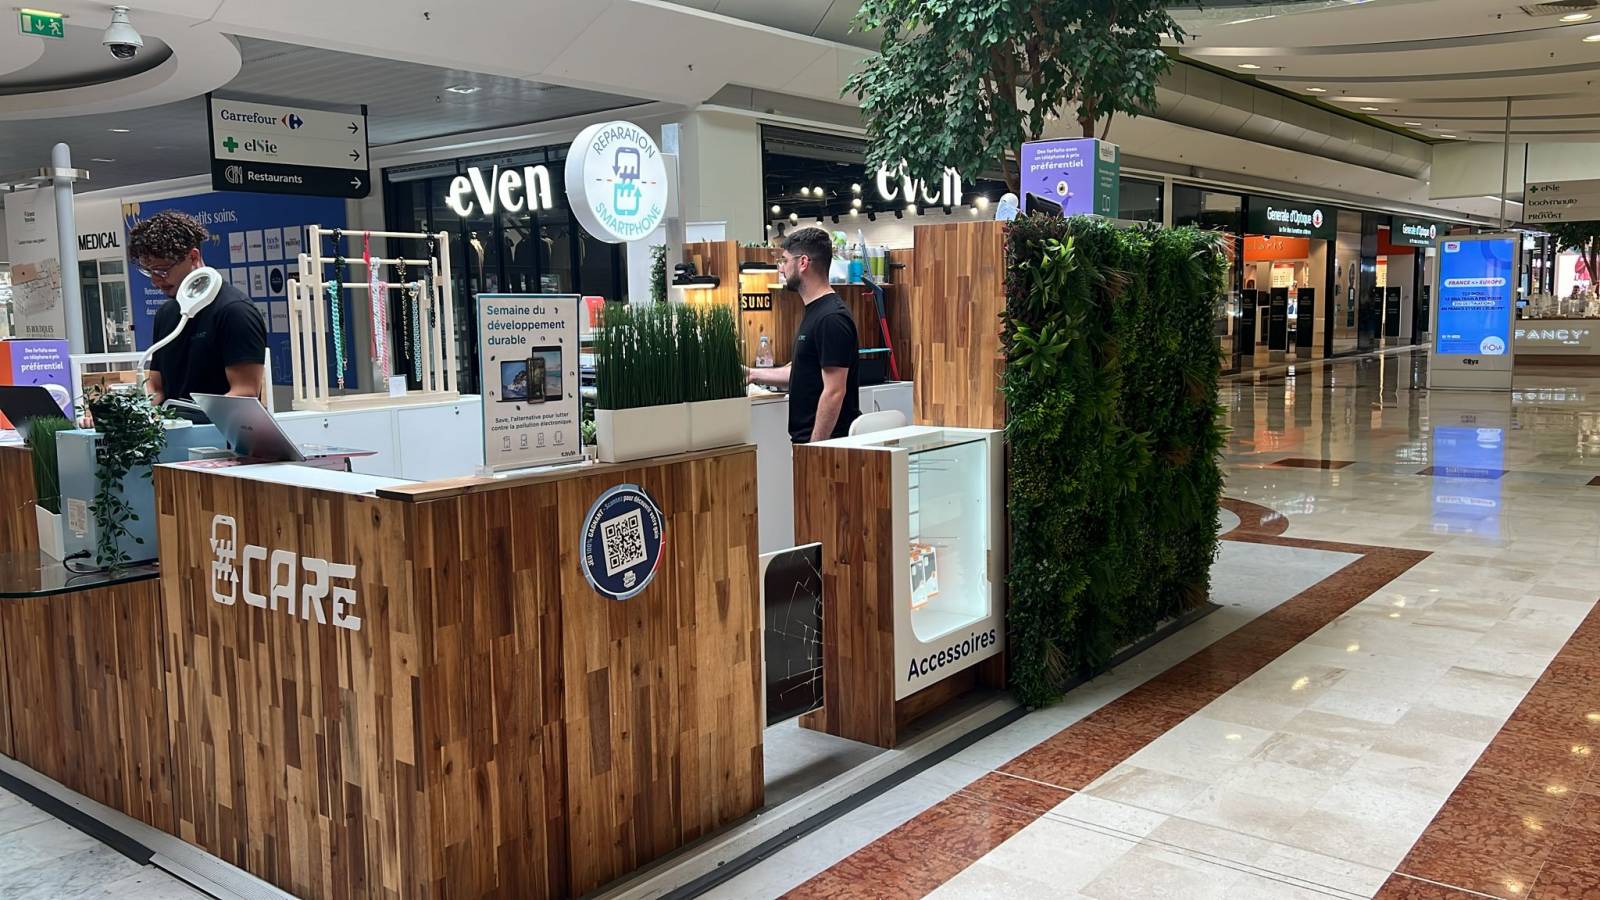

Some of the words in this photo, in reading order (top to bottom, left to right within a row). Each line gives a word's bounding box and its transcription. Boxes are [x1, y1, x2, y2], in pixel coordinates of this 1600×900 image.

[221, 109, 277, 125] Carrefour
[592, 126, 656, 159] REPARATION
[1030, 159, 1084, 173] préférentiel
[247, 171, 303, 184] Restaurants
[594, 202, 662, 237] SMARTPHONE
[77, 231, 120, 251] MEDICAL
[486, 305, 530, 316] Semaine
[533, 304, 546, 316] du
[487, 318, 566, 331] développement
[488, 333, 527, 346] durable
[20, 361, 64, 373] préférentiel
[510, 414, 541, 422] l'alternative
[542, 412, 554, 420] pour
[516, 421, 540, 430] pollution
[588, 508, 605, 539] GAGNANT
[242, 544, 361, 631] CARE
[907, 628, 996, 682] Accessoires
